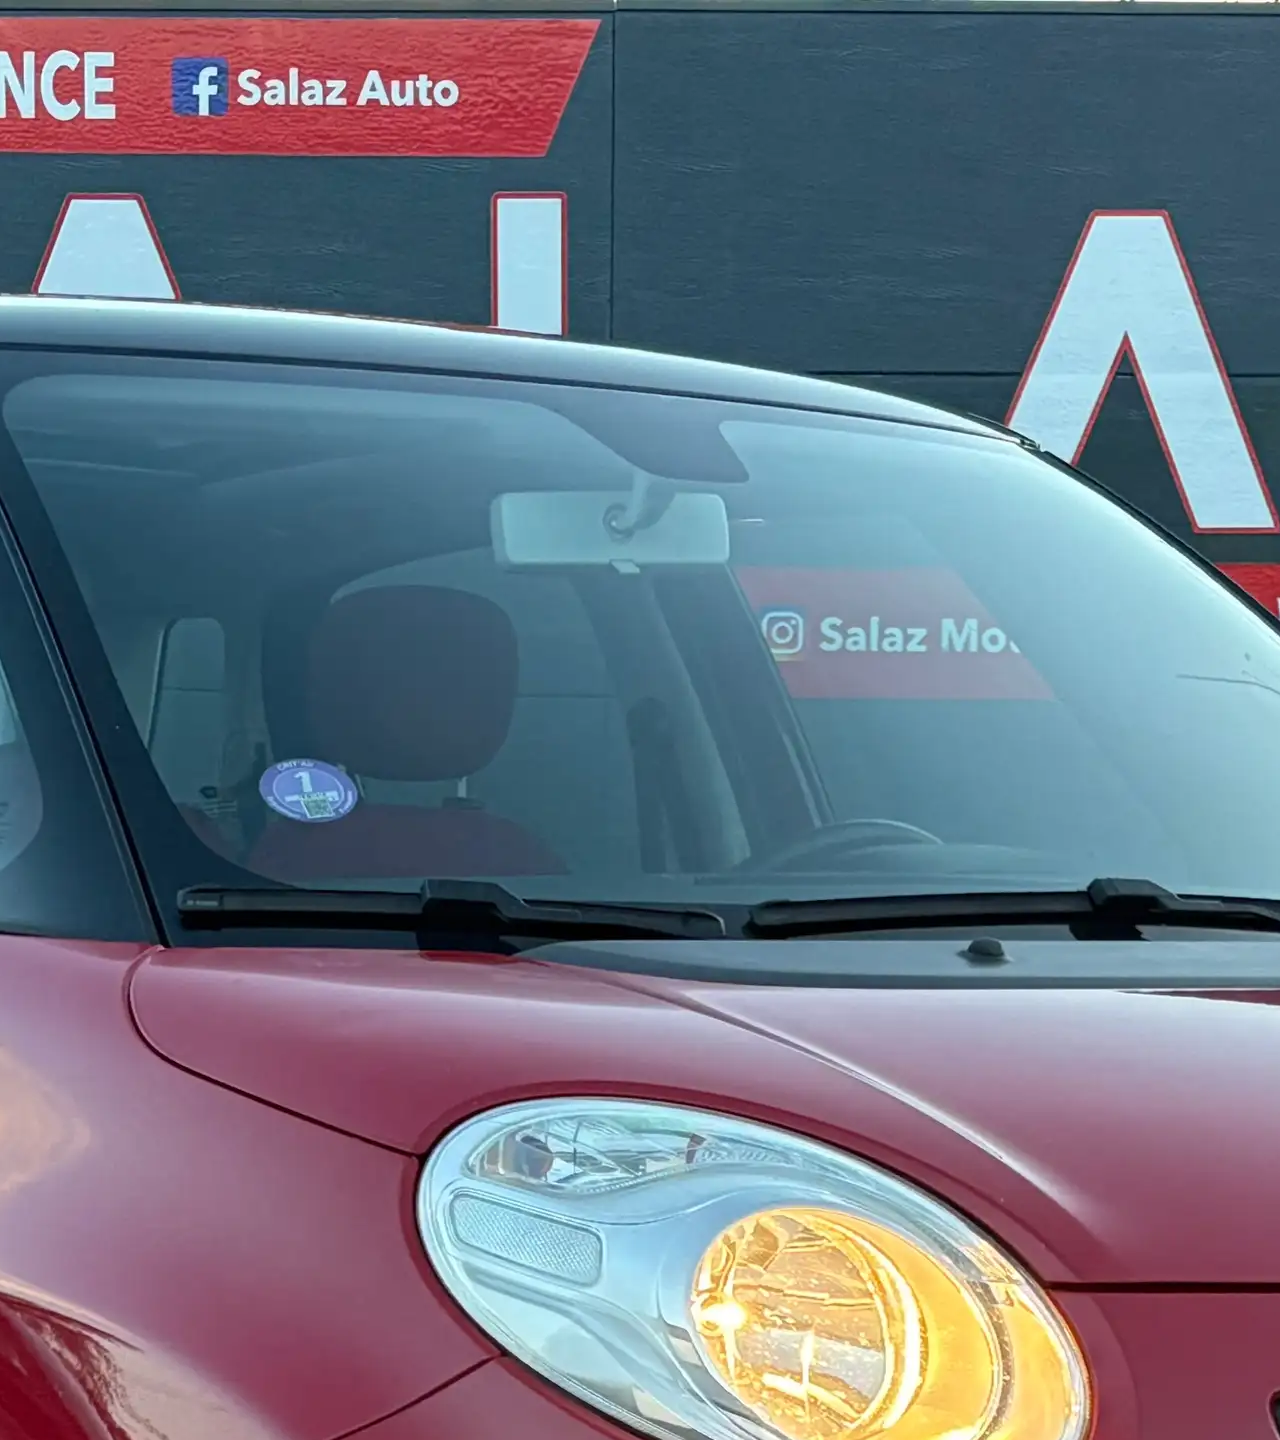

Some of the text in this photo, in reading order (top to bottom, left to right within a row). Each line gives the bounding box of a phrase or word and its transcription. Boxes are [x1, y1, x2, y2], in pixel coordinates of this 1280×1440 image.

[237, 68, 348, 108] Salaz
[357, 70, 460, 108] Auto
[820, 616, 1022, 654] Salaz Mo
[293, 771, 313, 793] 1
